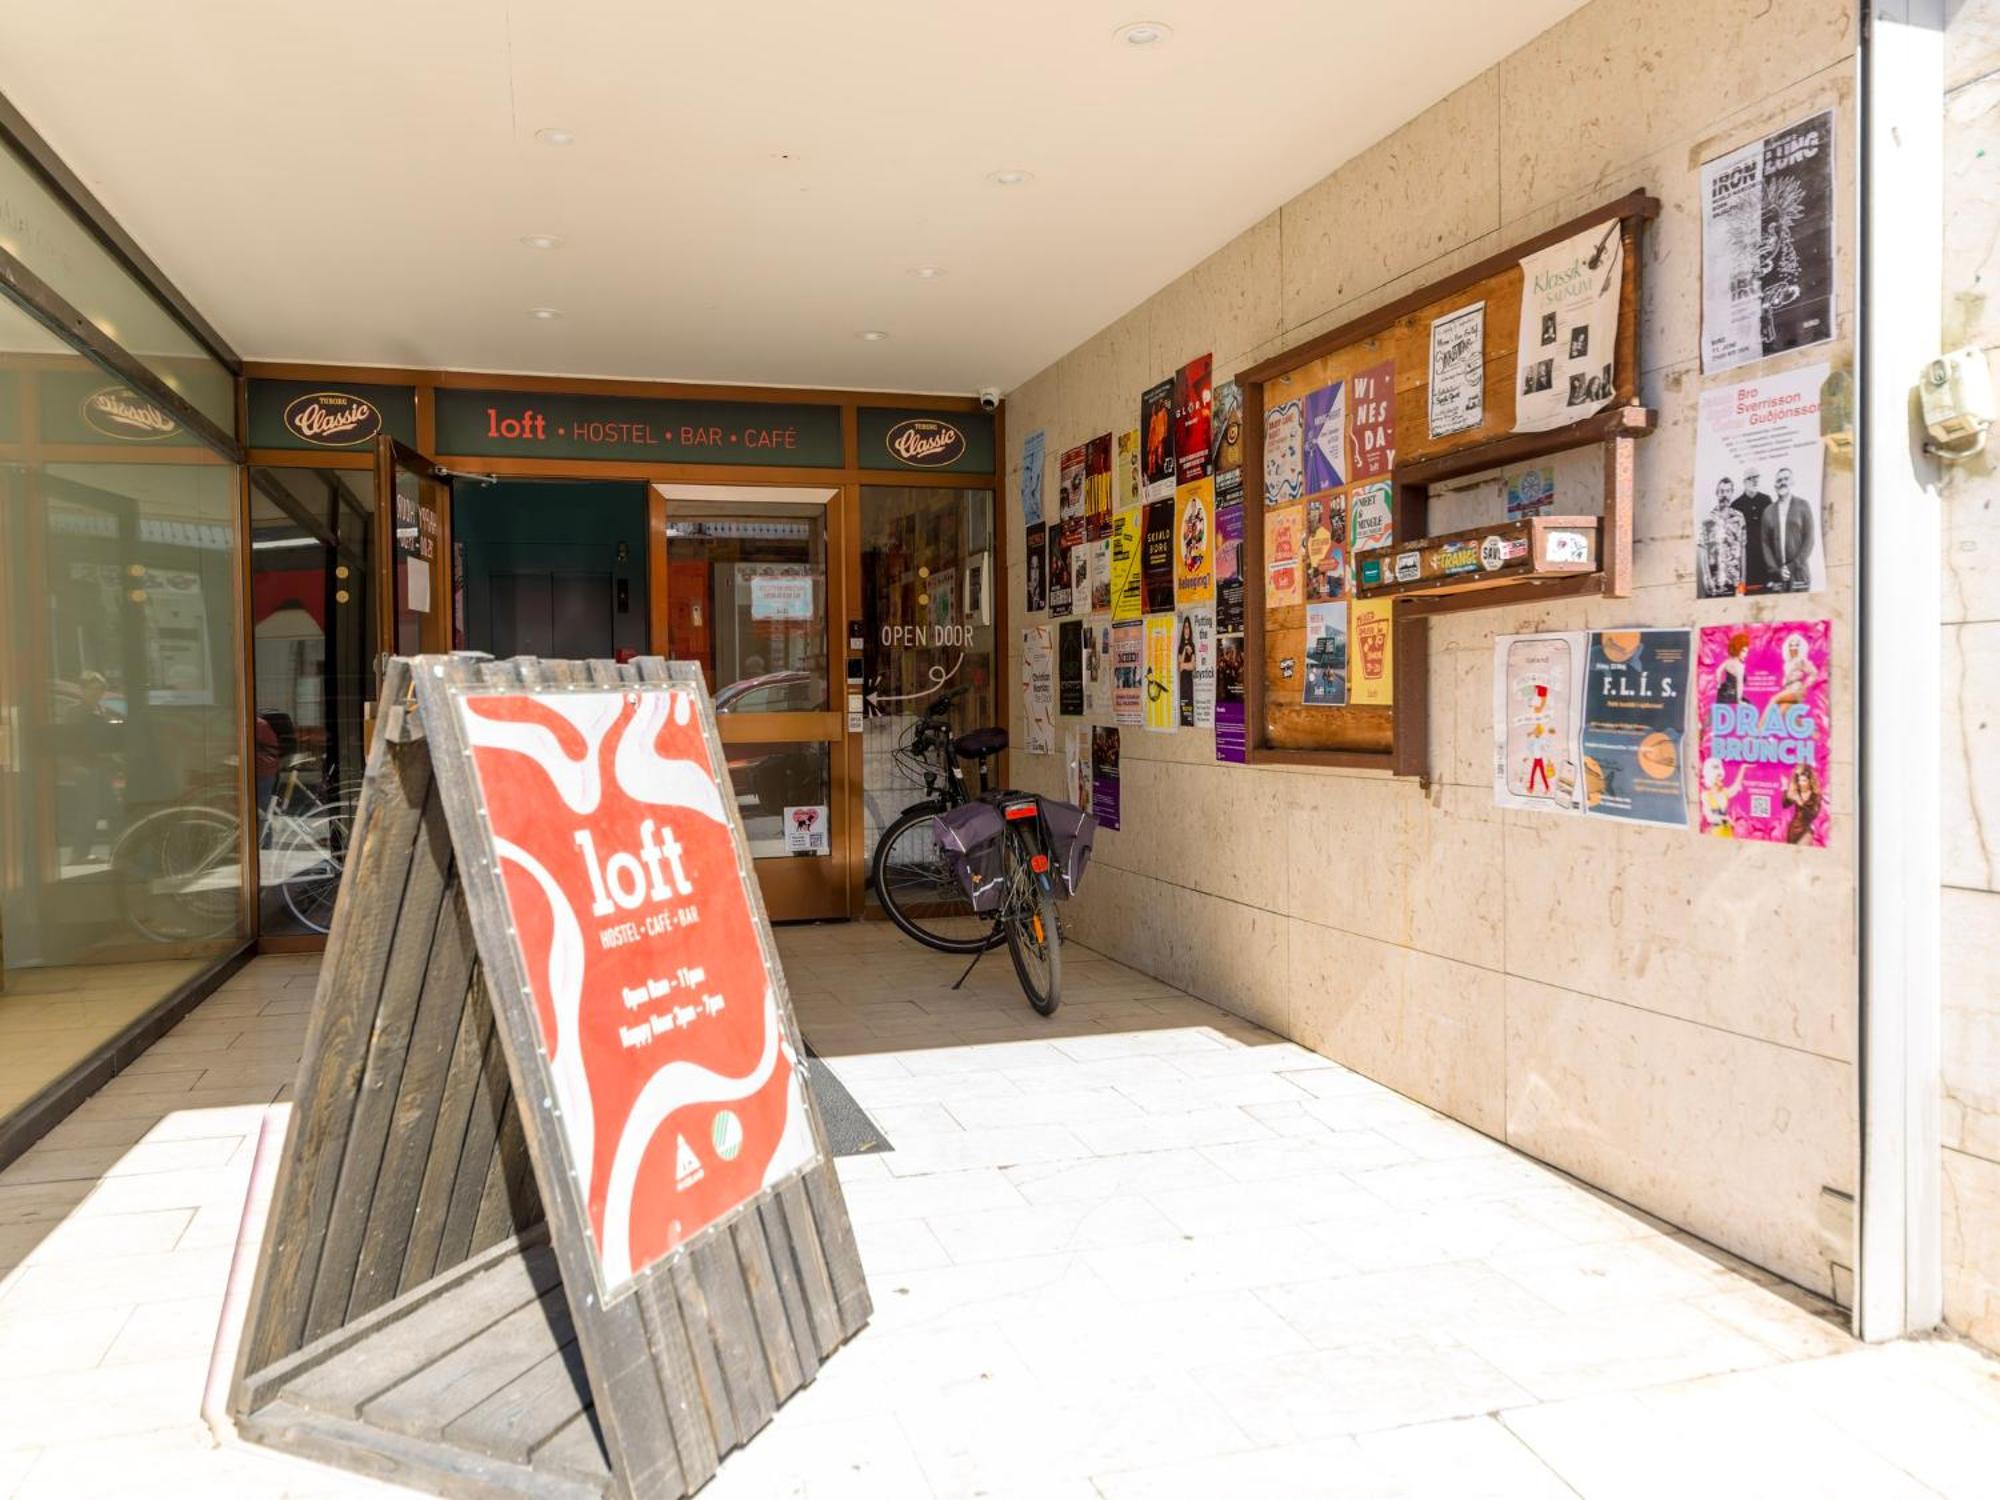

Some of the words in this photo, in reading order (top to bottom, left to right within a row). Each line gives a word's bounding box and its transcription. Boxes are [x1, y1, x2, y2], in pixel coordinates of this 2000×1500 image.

[1764, 131, 1820, 176] LUNG
[1712, 160, 1758, 198] IRON
[1354, 378, 1375, 400] WI
[1736, 392, 1801, 414] Sverrisson
[1737, 388, 1759, 401] Bro
[295, 403, 370, 436] Classic
[487, 408, 546, 440] loft
[574, 422, 659, 444] HOSTEL
[680, 427, 722, 448] BAR
[744, 427, 798, 449] CAFÉ
[1357, 402, 1387, 426] NES
[895, 428, 957, 458] Classic
[1365, 430, 1386, 450] DA
[881, 625, 927, 646] OPEN
[935, 625, 974, 647] DOOR
[1710, 703, 1815, 739] DRAG
[1712, 737, 1816, 767] BRUNCH
[573, 818, 693, 917] loft
[600, 923, 641, 949] HOSTEL
[645, 908, 672, 938] CAFÉ
[679, 905, 701, 928] BAR
[677, 966, 706, 990] 11pm
[619, 1024, 653, 1049] Happy
